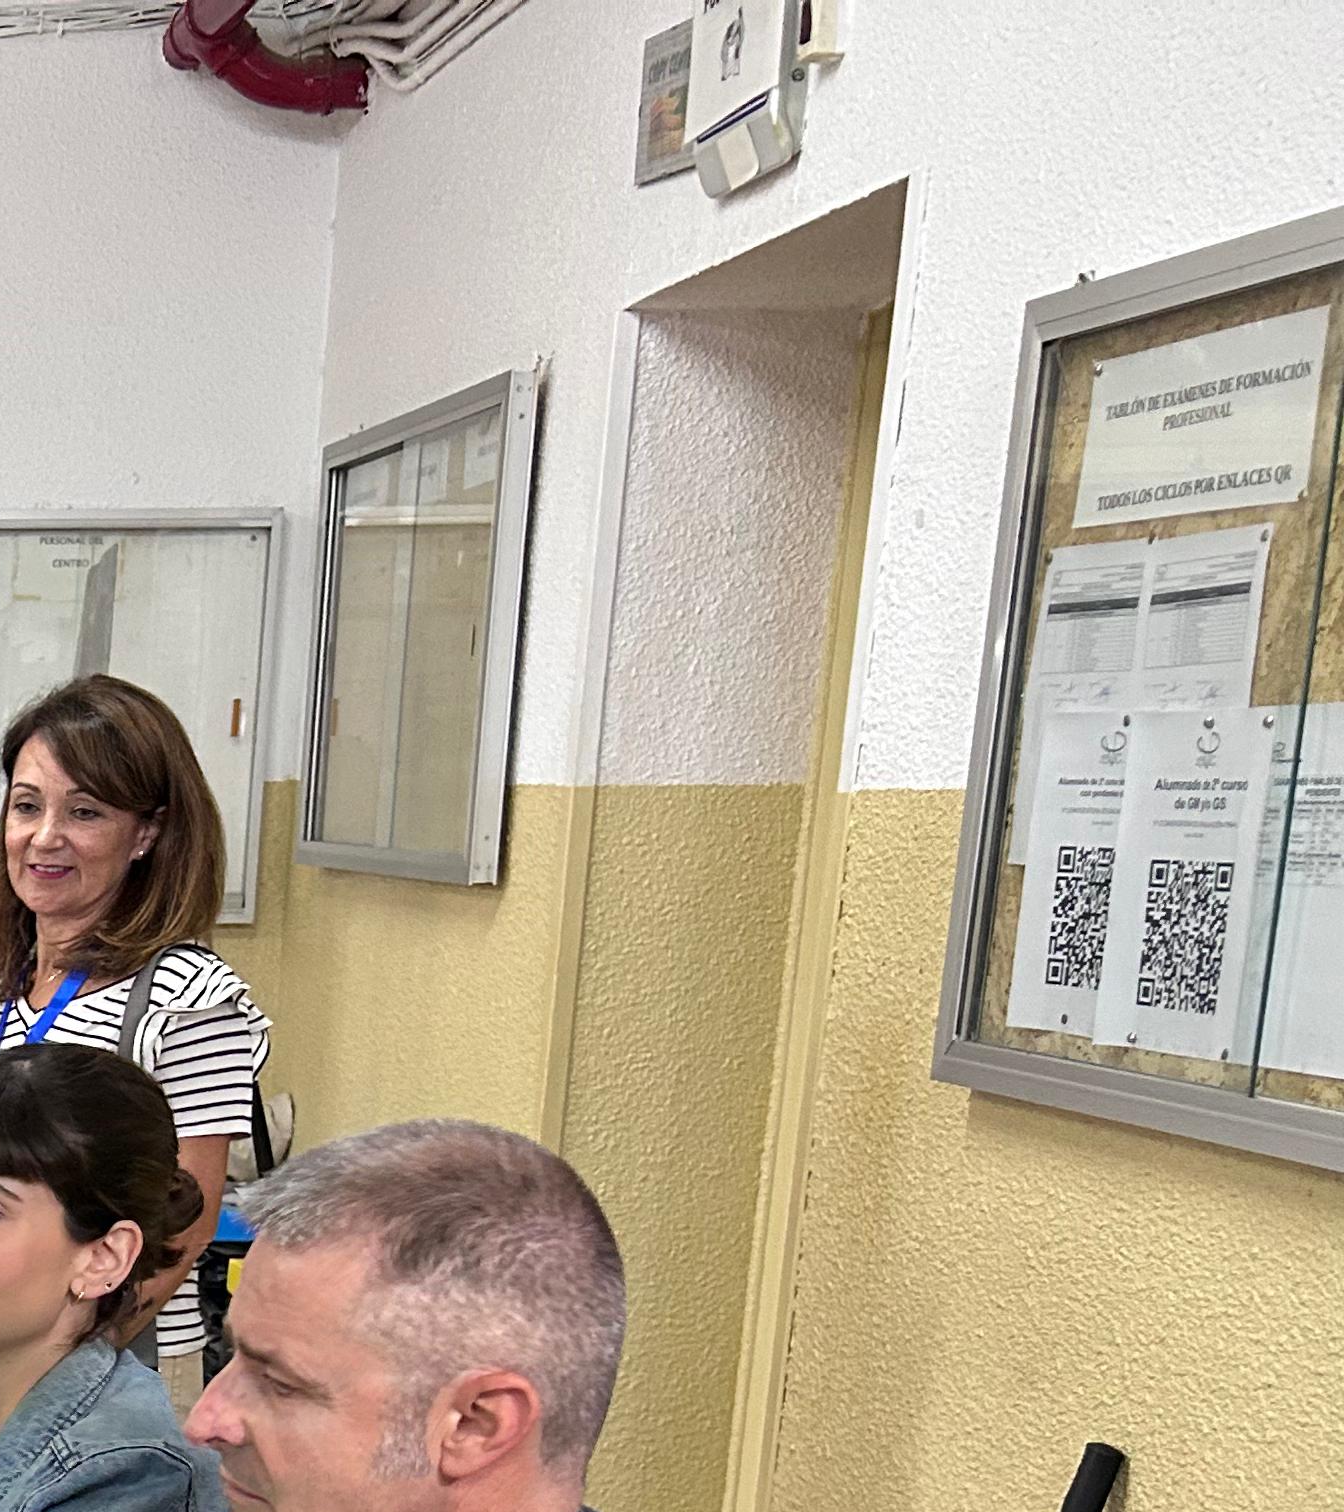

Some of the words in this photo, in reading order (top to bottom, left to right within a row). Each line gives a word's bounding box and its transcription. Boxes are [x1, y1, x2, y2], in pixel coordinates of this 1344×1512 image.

[1218, 376, 1236, 396] DE
[1236, 359, 1313, 392] FORMACIÓN
[1162, 401, 1234, 431] PROFESIONAL
[1097, 490, 1132, 511] TODOS
[1131, 488, 1154, 506] LOS
[1193, 477, 1216, 496] POR
[1216, 467, 1272, 492] ENLACES
[1221, 780, 1249, 791] curso
